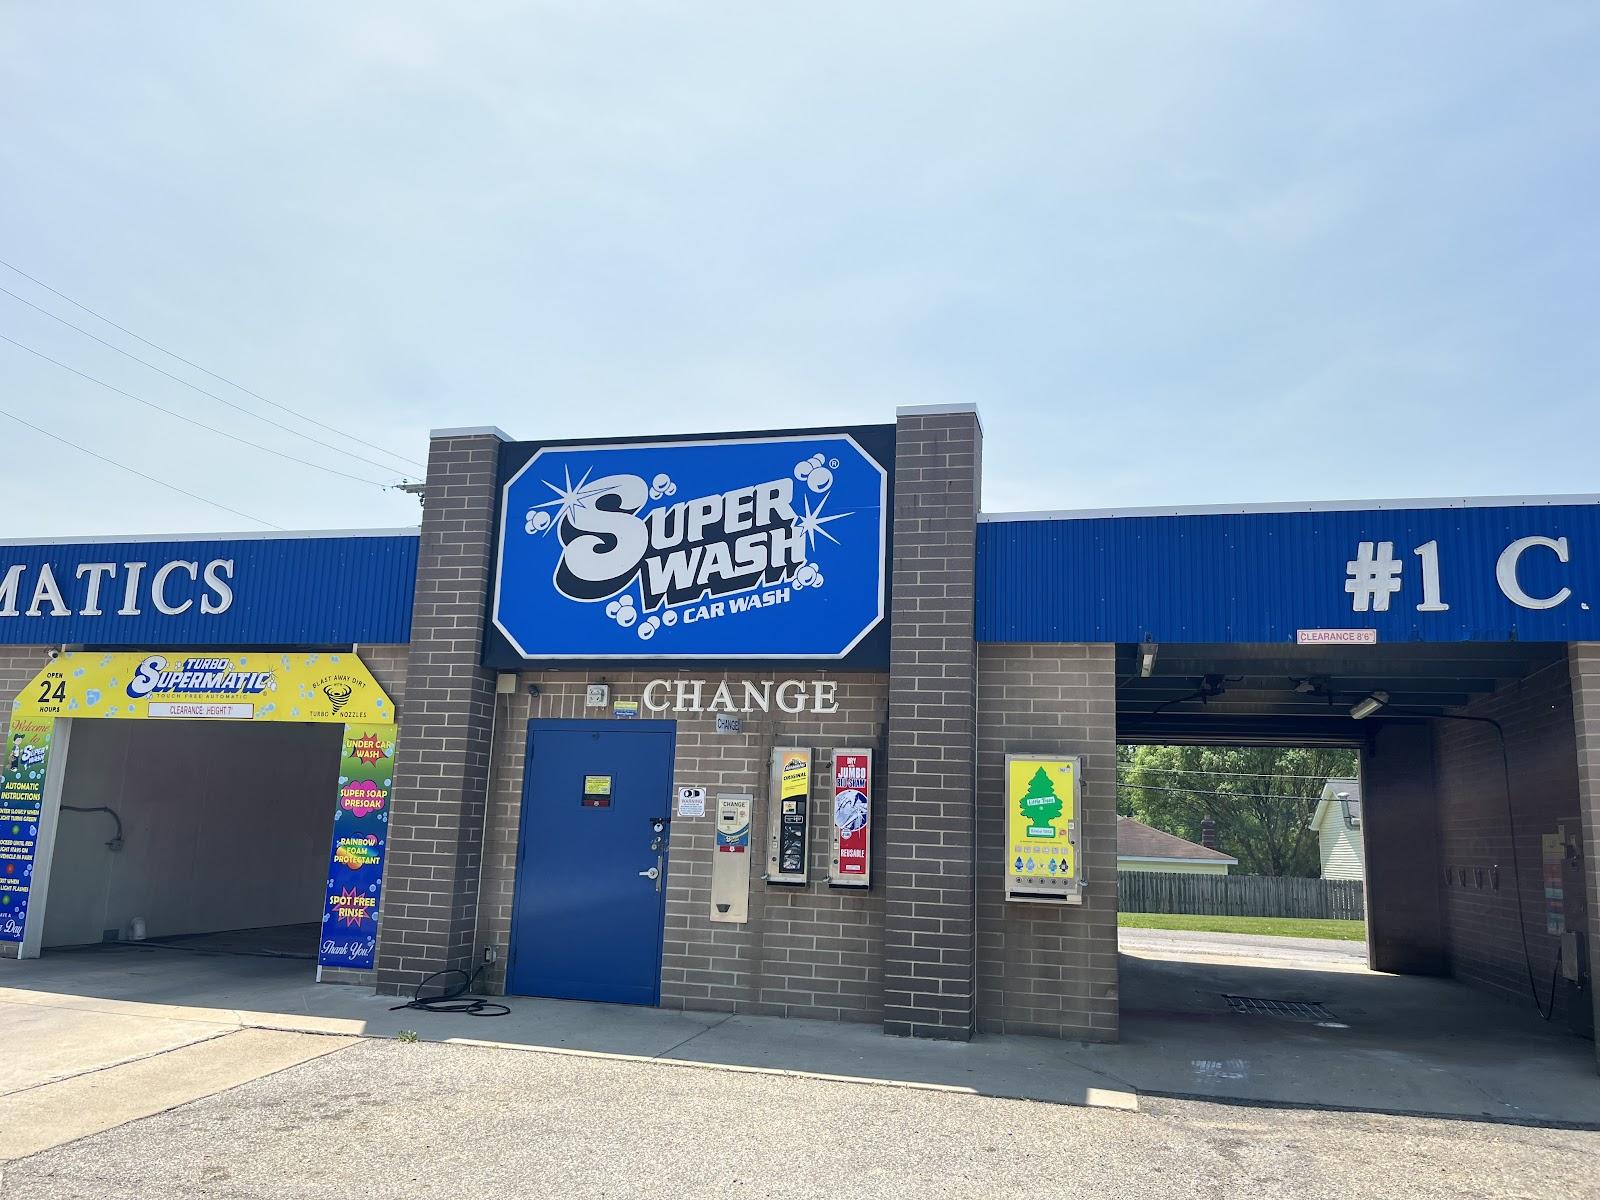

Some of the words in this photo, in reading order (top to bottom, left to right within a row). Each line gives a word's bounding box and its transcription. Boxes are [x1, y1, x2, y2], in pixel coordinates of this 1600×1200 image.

[557, 474, 797, 590] SUPER
[643, 525, 808, 600] WASH
[1344, 539, 1450, 612] #1
[682, 603, 725, 624] CAR
[729, 587, 791, 614] WASH
[1299, 632, 1355, 641] CLEARANCE
[183, 658, 230, 671] TURBO
[127, 655, 270, 697] SUPERMATIC
[312, 676, 332, 689] BLAST
[351, 677, 367, 689] DIRT
[37, 680, 67, 703] 24
[642, 678, 840, 714] CHANGE
[12, 720, 50, 733] Welcome
[346, 740, 373, 749] UNDER
[375, 740, 391, 749] CAR
[356, 750, 380, 759] WASH
[837, 767, 866, 779] JUMBO
[5, 782, 40, 791] AUTOMATIC
[1, 791, 41, 801] INSTRUCTIONS
[340, 789, 365, 798] SUPER
[366, 789, 388, 798] SOAP
[344, 799, 382, 808] PRESOAK
[339, 837, 376, 847] RAINBOW
[345, 846, 368, 855] FOAM
[333, 855, 380, 865] PROTECTANT
[329, 895, 353, 906] SPOT
[353, 896, 376, 907] FREE
[338, 907, 365, 918] RINSE
[4, 919, 23, 938] Day
[320, 939, 349, 956] Thank
[348, 941, 374, 961] You!
